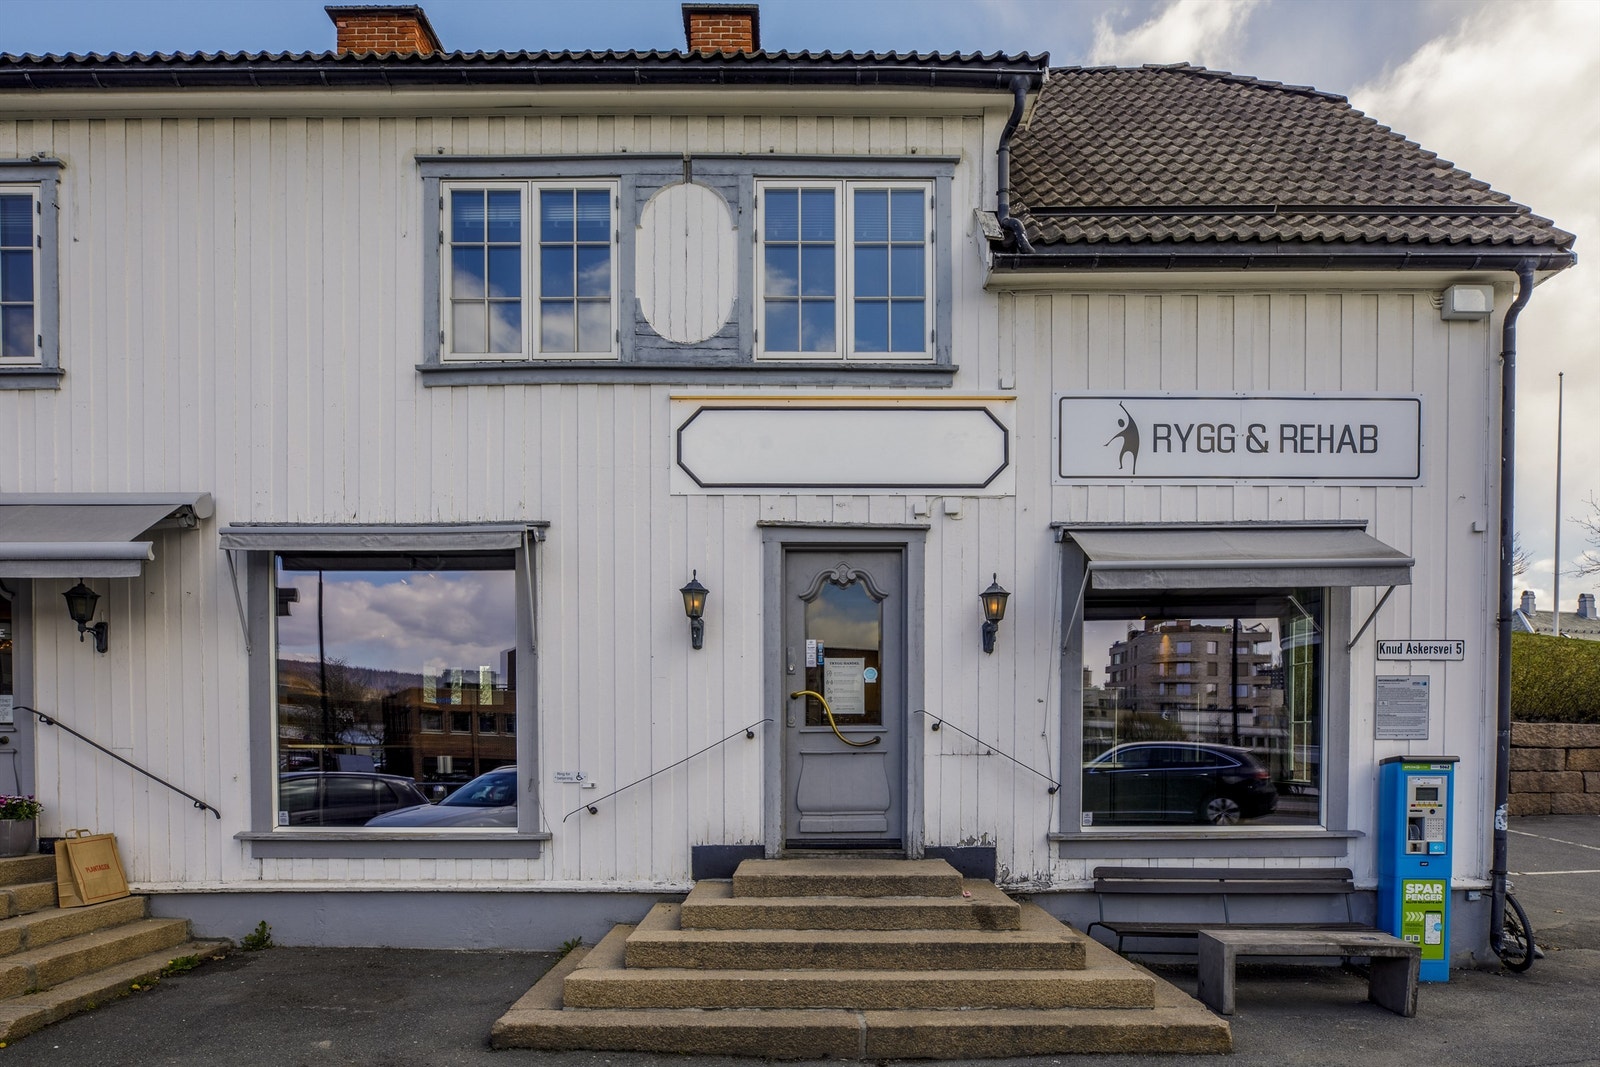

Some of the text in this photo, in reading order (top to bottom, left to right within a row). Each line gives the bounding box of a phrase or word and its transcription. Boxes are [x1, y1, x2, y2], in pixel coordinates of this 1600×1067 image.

[1152, 423, 1378, 454] RYGG & REHAB
[1379, 642, 1462, 655] Knud Askersvei 5
[1405, 883, 1443, 894] SPAR
